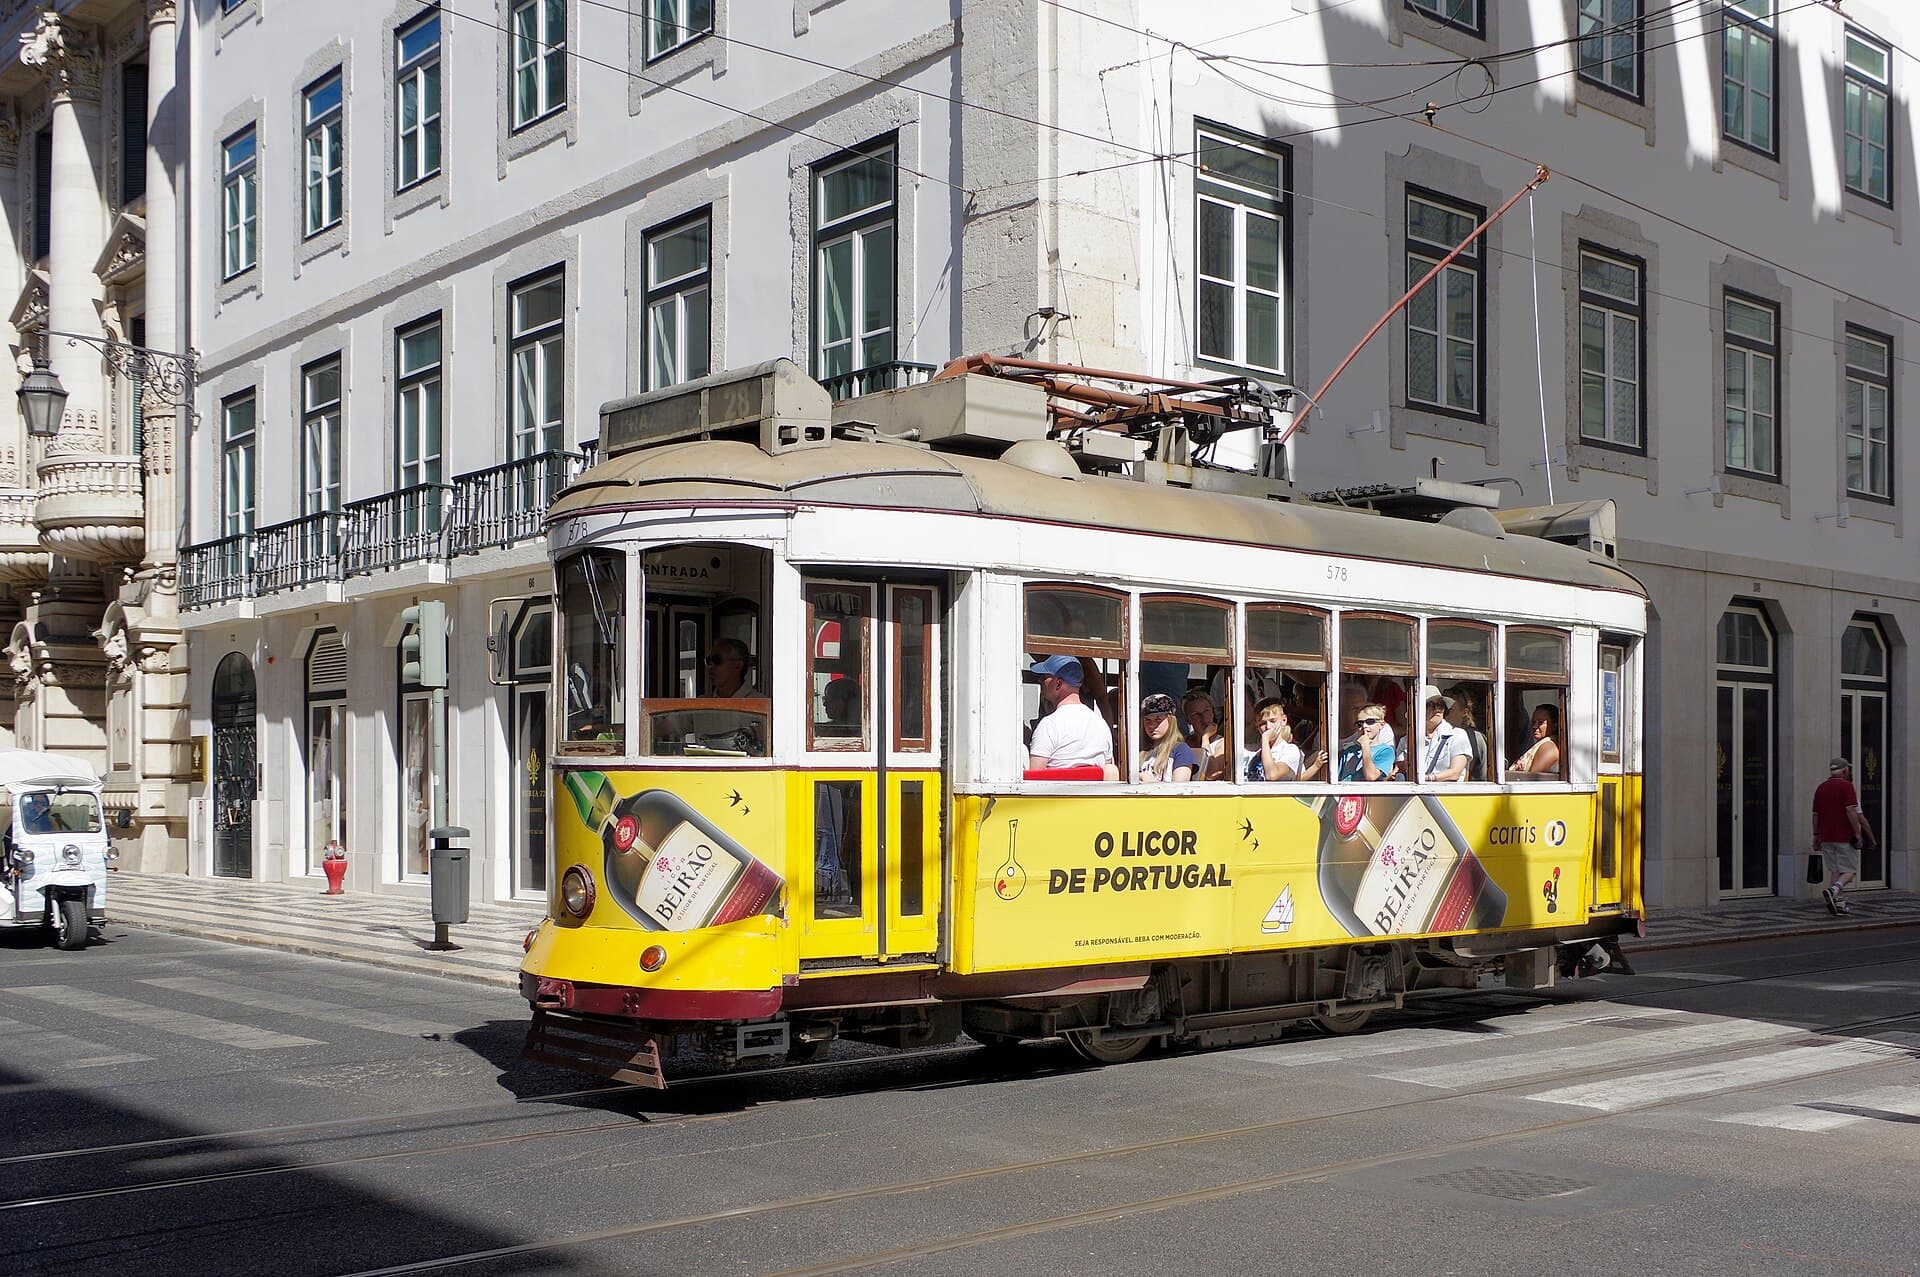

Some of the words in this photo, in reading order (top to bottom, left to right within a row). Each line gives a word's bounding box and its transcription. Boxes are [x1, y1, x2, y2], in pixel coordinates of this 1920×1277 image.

[724, 384, 750, 419] 28
[569, 522, 588, 540] 578
[644, 564, 708, 578] ENTRADA
[1326, 565, 1348, 581] 578
[1094, 831, 1114, 858] O
[1121, 830, 1197, 857] LICOR
[1489, 819, 1536, 845] carris
[655, 844, 713, 922] BEIRÃO
[1048, 868, 1087, 895] DE
[1093, 863, 1232, 893] PORTUGAL
[1374, 828, 1436, 935] BEIRÃO
[1384, 846, 1411, 892] LICOR
[1134, 935, 1150, 943] BEBA
[1151, 934, 1164, 942] COM
